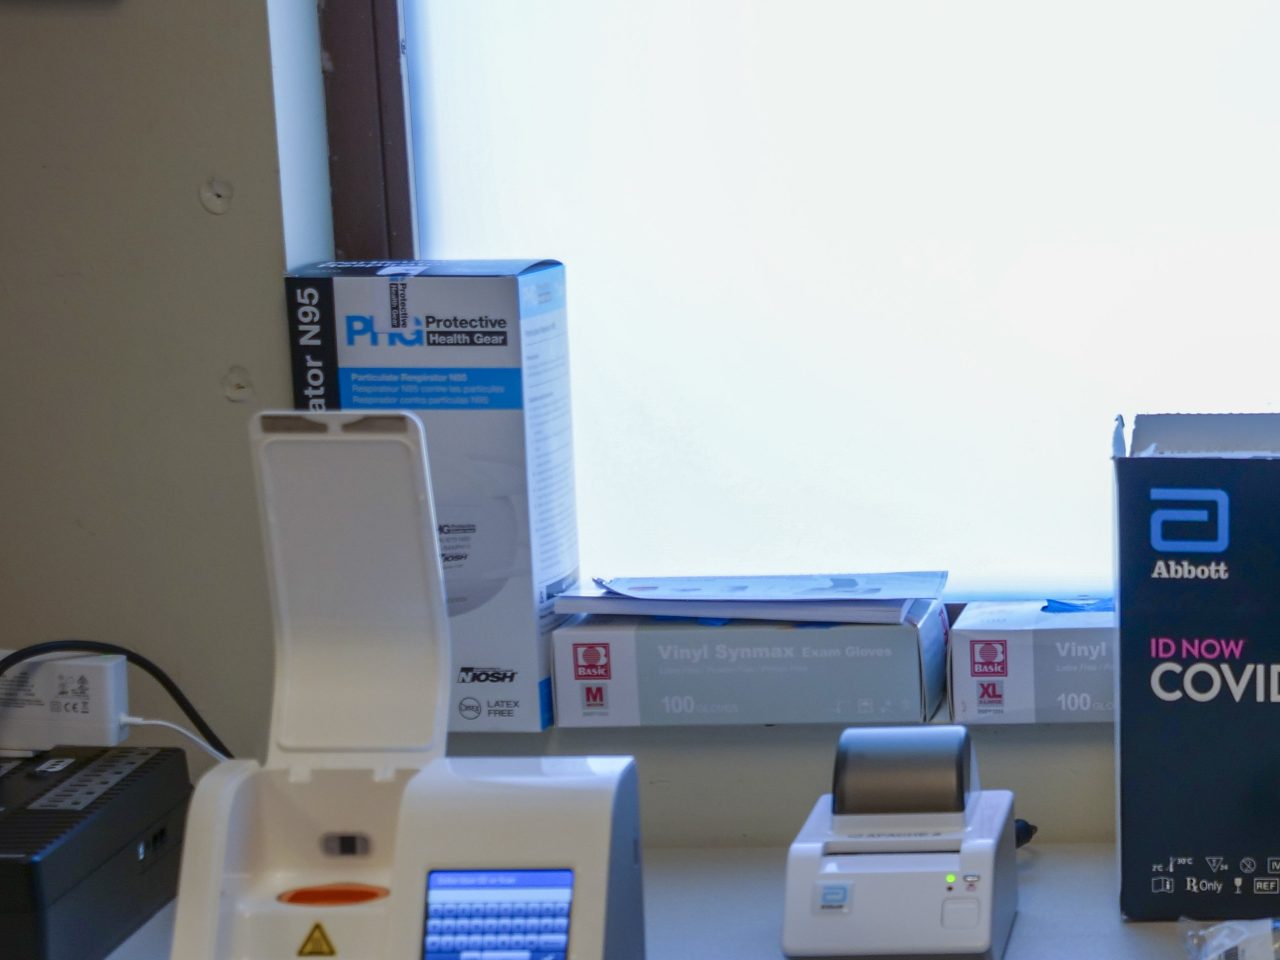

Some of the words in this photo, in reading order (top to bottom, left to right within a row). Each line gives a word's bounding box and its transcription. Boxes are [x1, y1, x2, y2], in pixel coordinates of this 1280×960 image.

[399, 283, 409, 328] Protective
[296, 288, 321, 345] N95
[425, 315, 507, 329] Protective
[429, 333, 469, 345] Health
[473, 333, 504, 345] Gear
[302, 355, 325, 411] ator
[1151, 559, 1230, 580] Abbott
[658, 643, 709, 664] Vinyl
[714, 643, 795, 664] Synmax
[801, 646, 842, 659] Exam
[845, 645, 893, 658] Gloves
[1056, 641, 1107, 661] Vinyl
[1150, 637, 1177, 659] ID
[1181, 638, 1244, 660] NOW
[456, 669, 516, 684] NIOSH
[585, 686, 604, 703] M
[979, 682, 1003, 699] XL
[487, 700, 520, 709] LATEX
[661, 695, 695, 714] 100
[1057, 693, 1092, 712] 100
[487, 709, 514, 718] FREE
[1199, 880, 1223, 894] Only
[1256, 881, 1276, 891] REF
